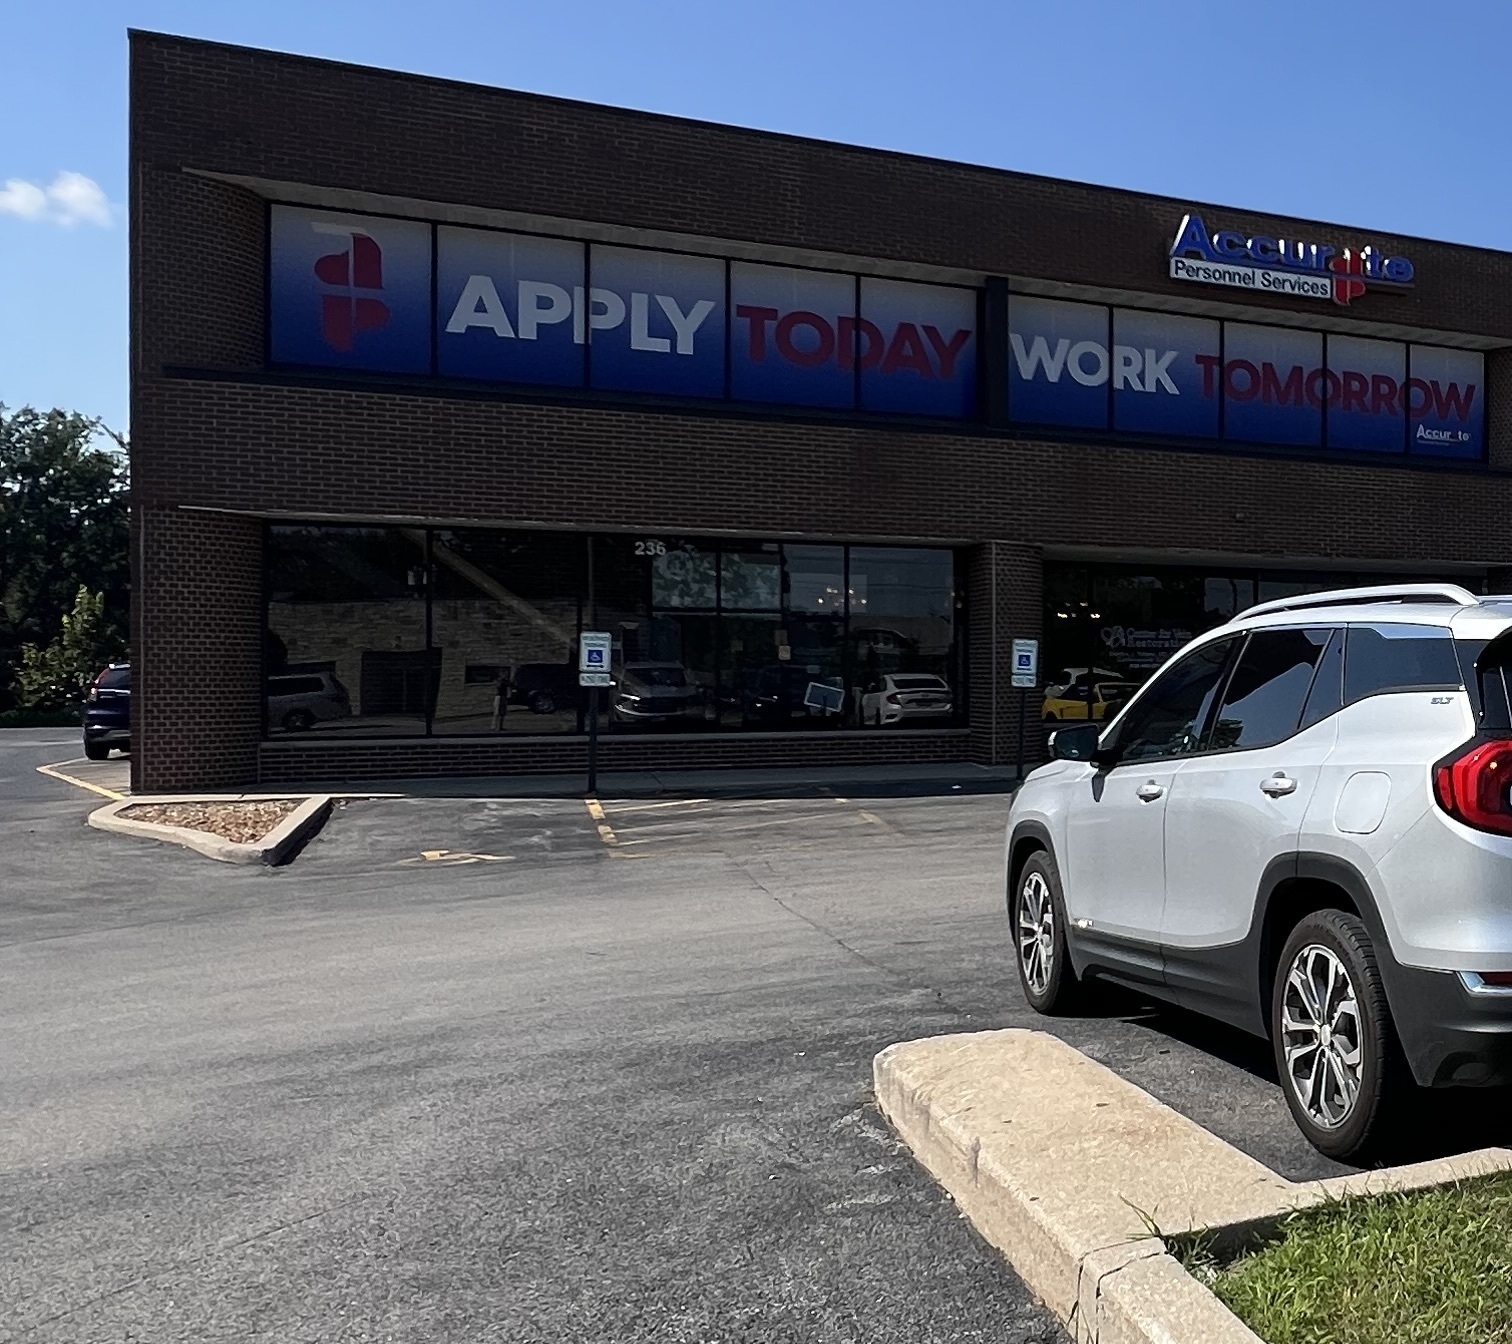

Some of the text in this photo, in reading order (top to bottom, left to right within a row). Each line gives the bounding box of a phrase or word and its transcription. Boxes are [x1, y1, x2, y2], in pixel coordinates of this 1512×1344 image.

[1174, 260, 1330, 297] Personnel Services
[445, 274, 973, 380] APPLY TODAY
[1009, 332, 1476, 423] WORK TOMORROW
[634, 541, 667, 556] 236
[1430, 696, 1455, 705] SLT
